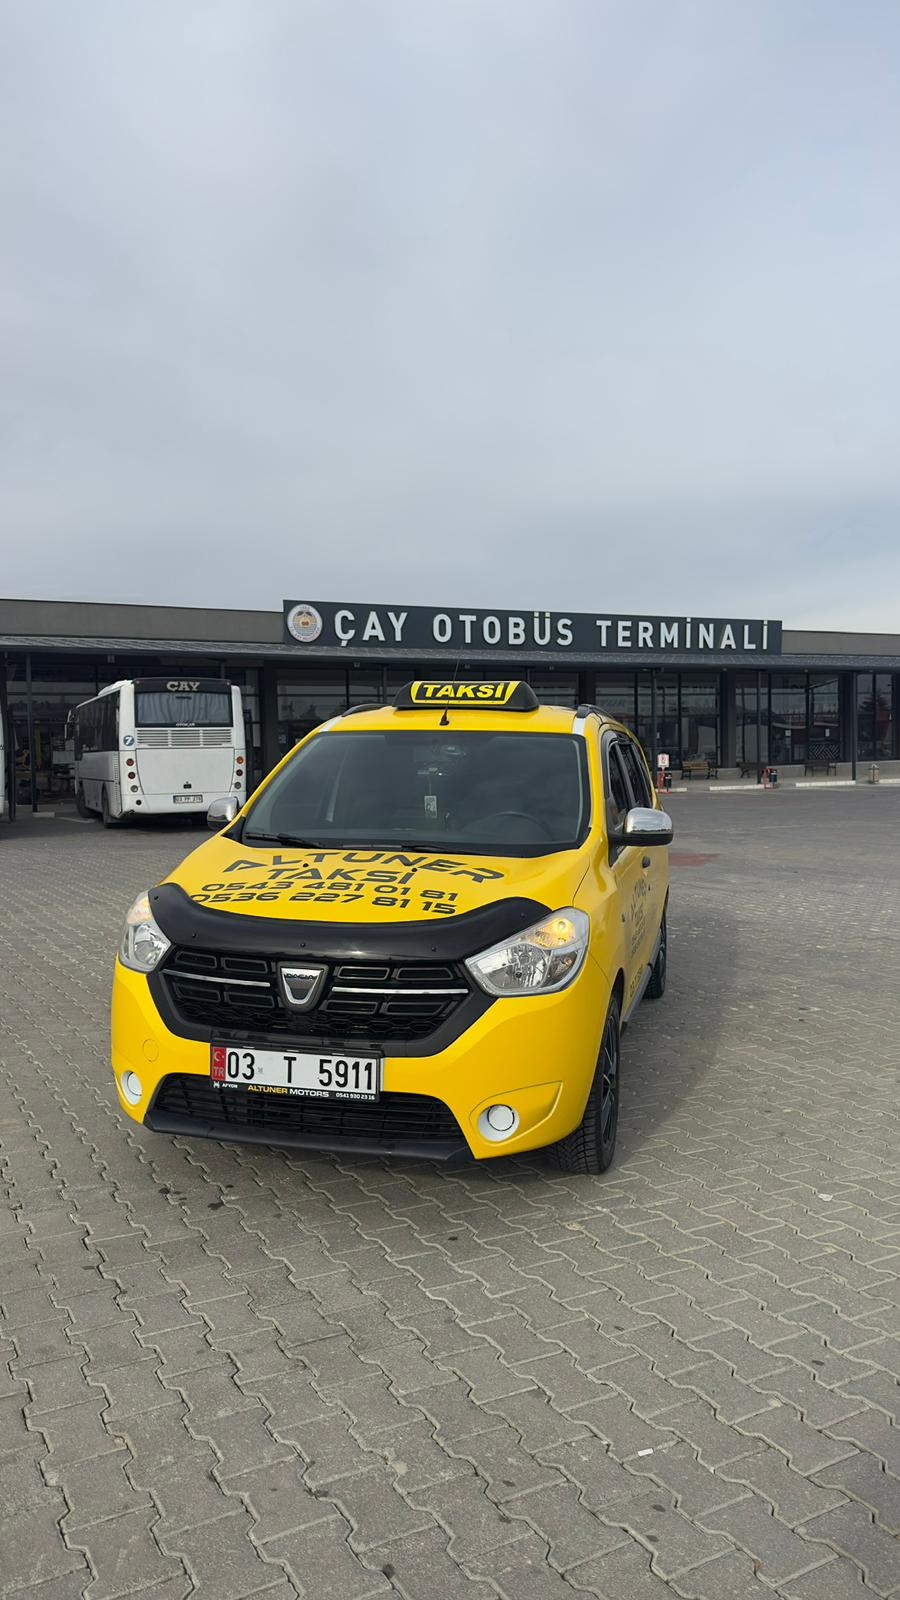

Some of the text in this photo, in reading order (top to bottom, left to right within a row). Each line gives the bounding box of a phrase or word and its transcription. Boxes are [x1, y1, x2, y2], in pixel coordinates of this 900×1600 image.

[334, 609, 408, 647] ÇAY
[432, 611, 574, 646] OTOBÜS
[596, 617, 768, 650] TERMİNALİ
[423, 682, 504, 698] TAKSİ
[222, 852, 505, 883] ALTUNER
[201, 881, 458, 901] 0543 481 01 81
[190, 892, 457, 915] 0536 227 81 15
[213, 1051, 373, 1090] TR 03 T 5911
[247, 1084, 288, 1095] ALTUNER
[289, 1087, 330, 1098] MOTORS
